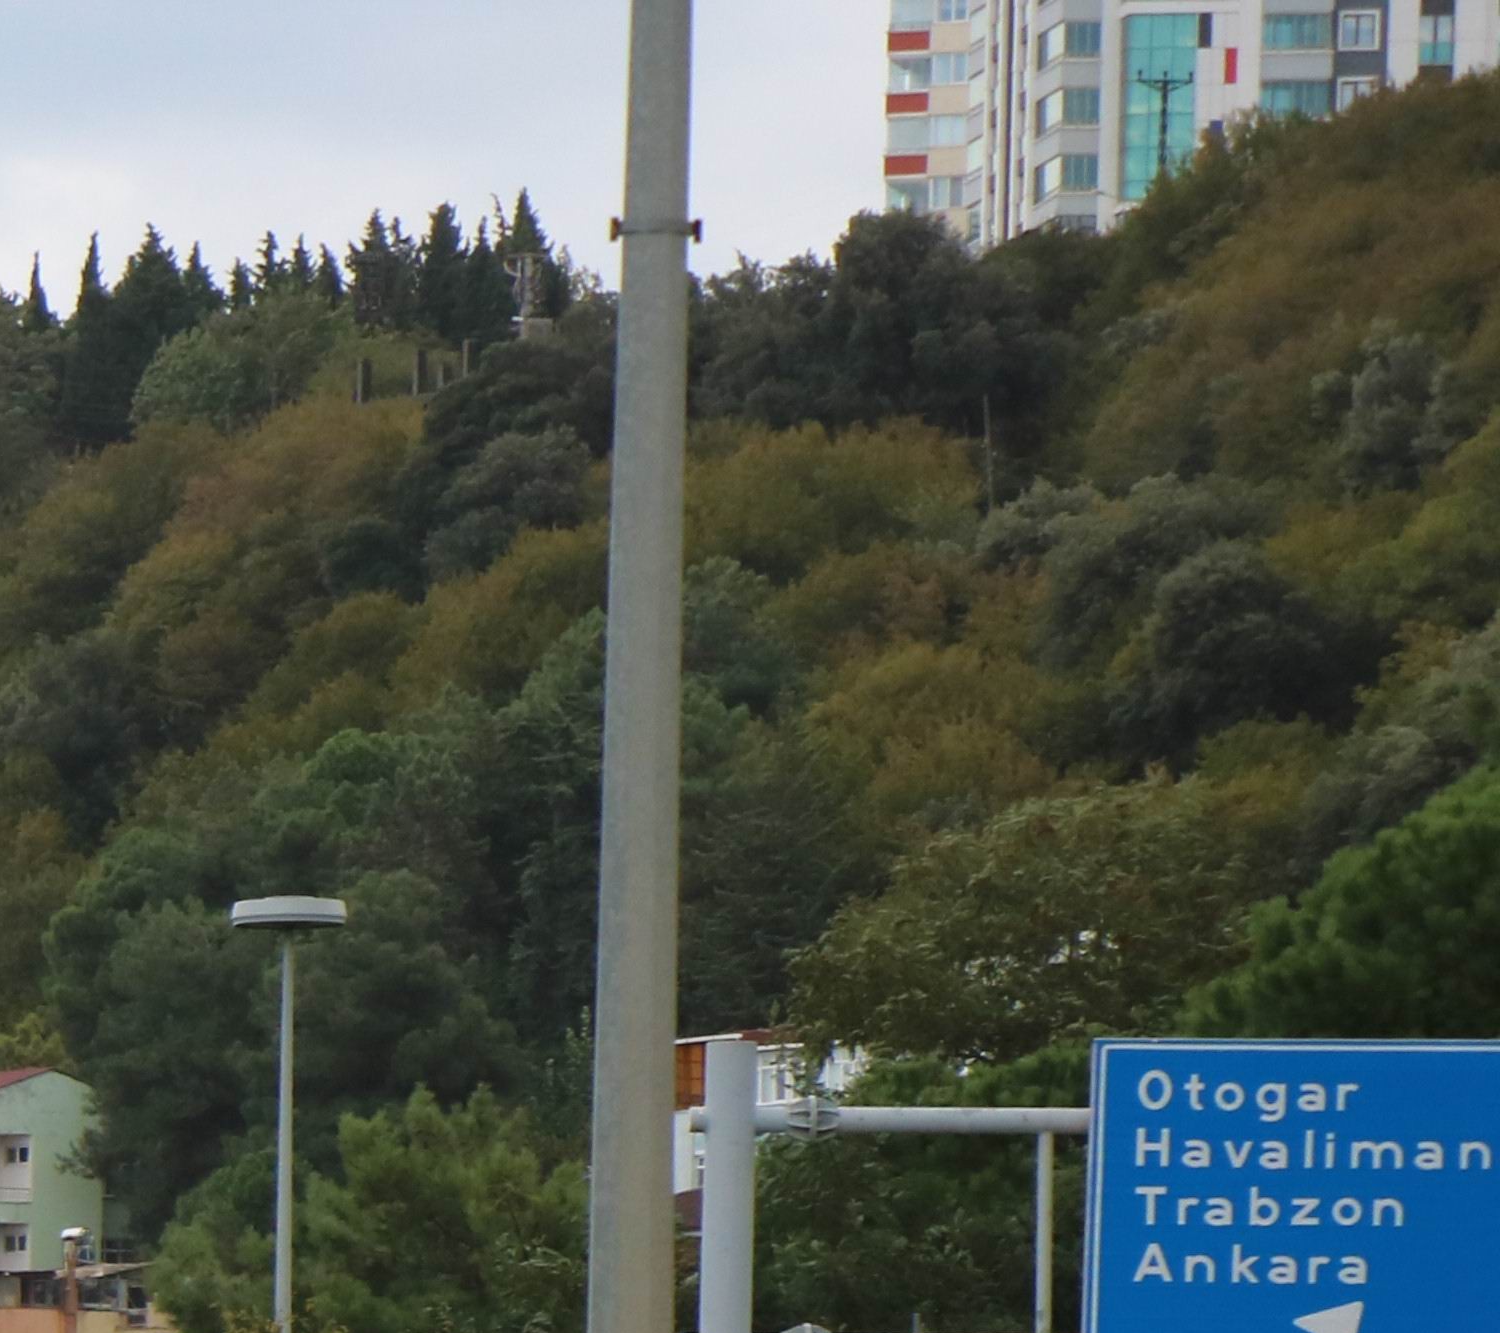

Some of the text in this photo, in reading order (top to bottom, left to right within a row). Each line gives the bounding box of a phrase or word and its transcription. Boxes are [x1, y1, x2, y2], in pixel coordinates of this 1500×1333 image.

[1138, 1069, 1360, 1122] Otogar
[1134, 1127, 1493, 1171] Havaliman
[1134, 1187, 1404, 1228] Trabzon
[1133, 1243, 1369, 1284] Ankara
